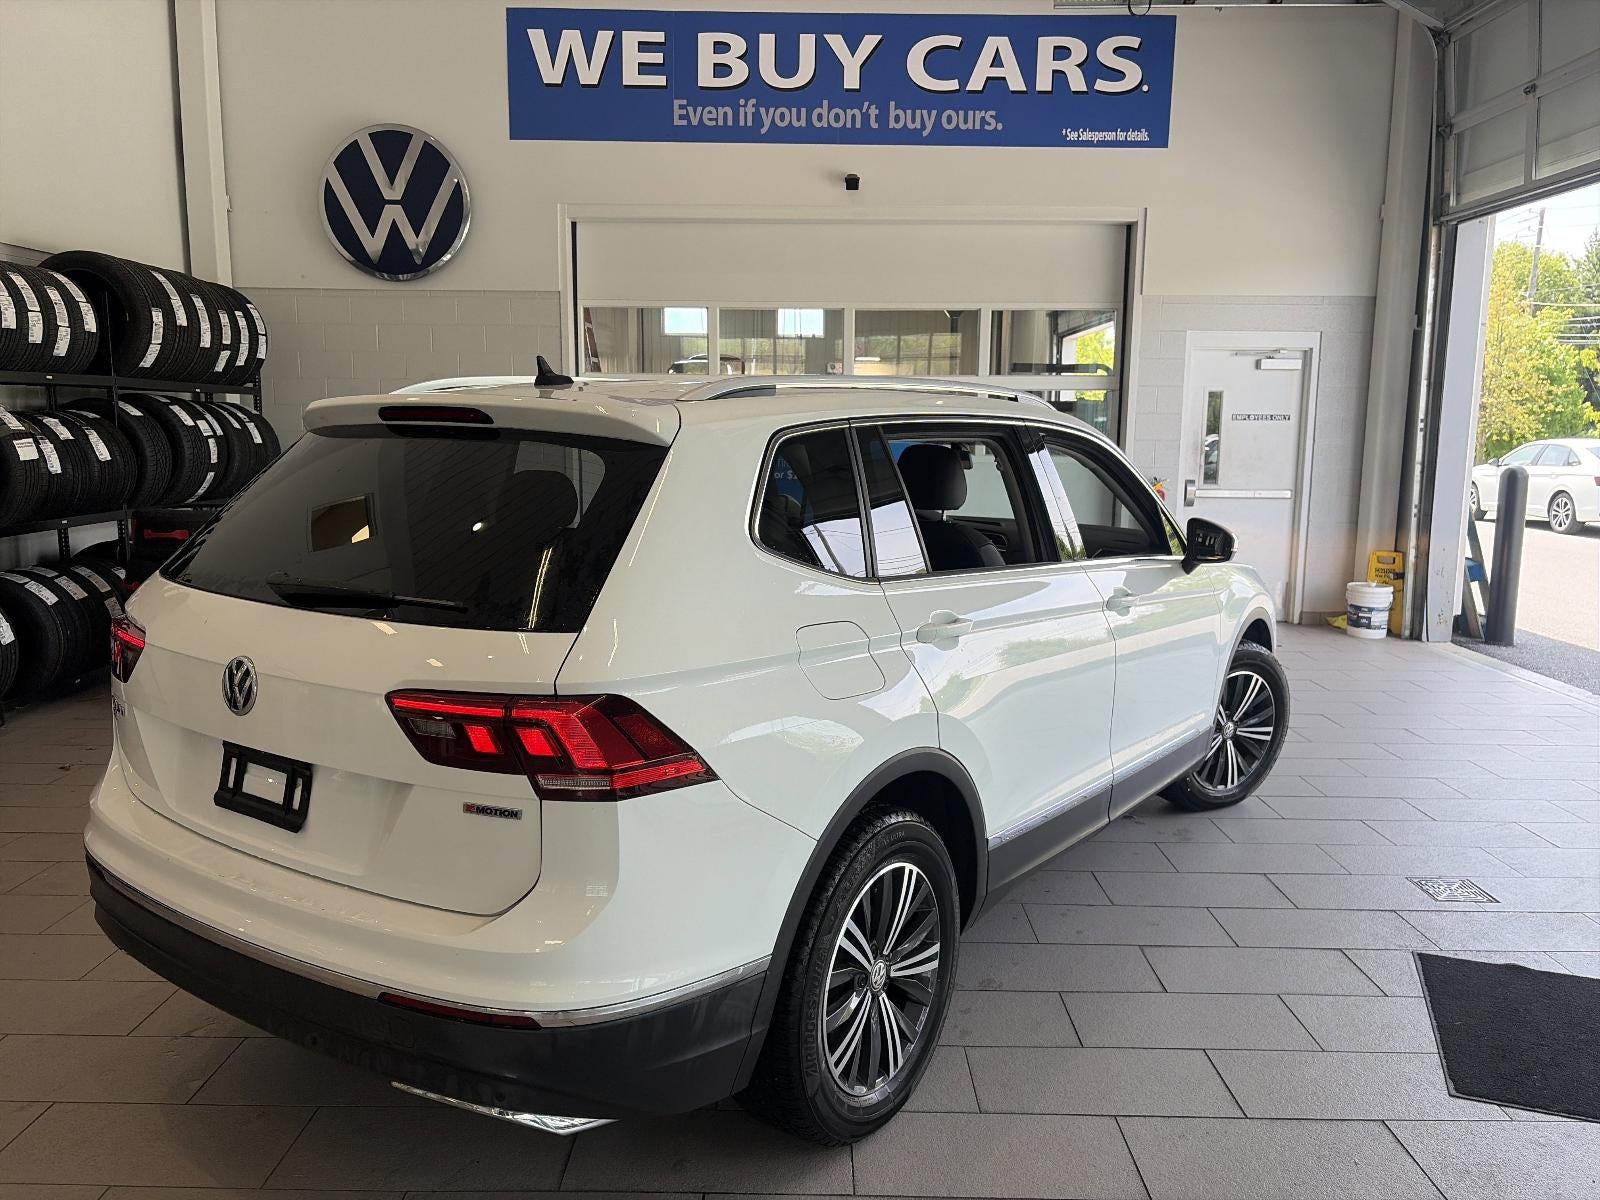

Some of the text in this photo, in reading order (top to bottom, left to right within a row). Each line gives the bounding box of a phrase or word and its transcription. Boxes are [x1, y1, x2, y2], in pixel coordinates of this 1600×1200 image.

[526, 28, 1150, 93] WE BUY CARS.
[673, 99, 1003, 137] Even if you don't buy ours.
[1079, 128, 1116, 143] Salesperson
[1117, 128, 1126, 141] for
[1127, 128, 1149, 141] details.
[319, 123, 471, 282] VW
[1232, 413, 1290, 422] EMPLOYEES ONLY
[222, 656, 257, 716] VW
